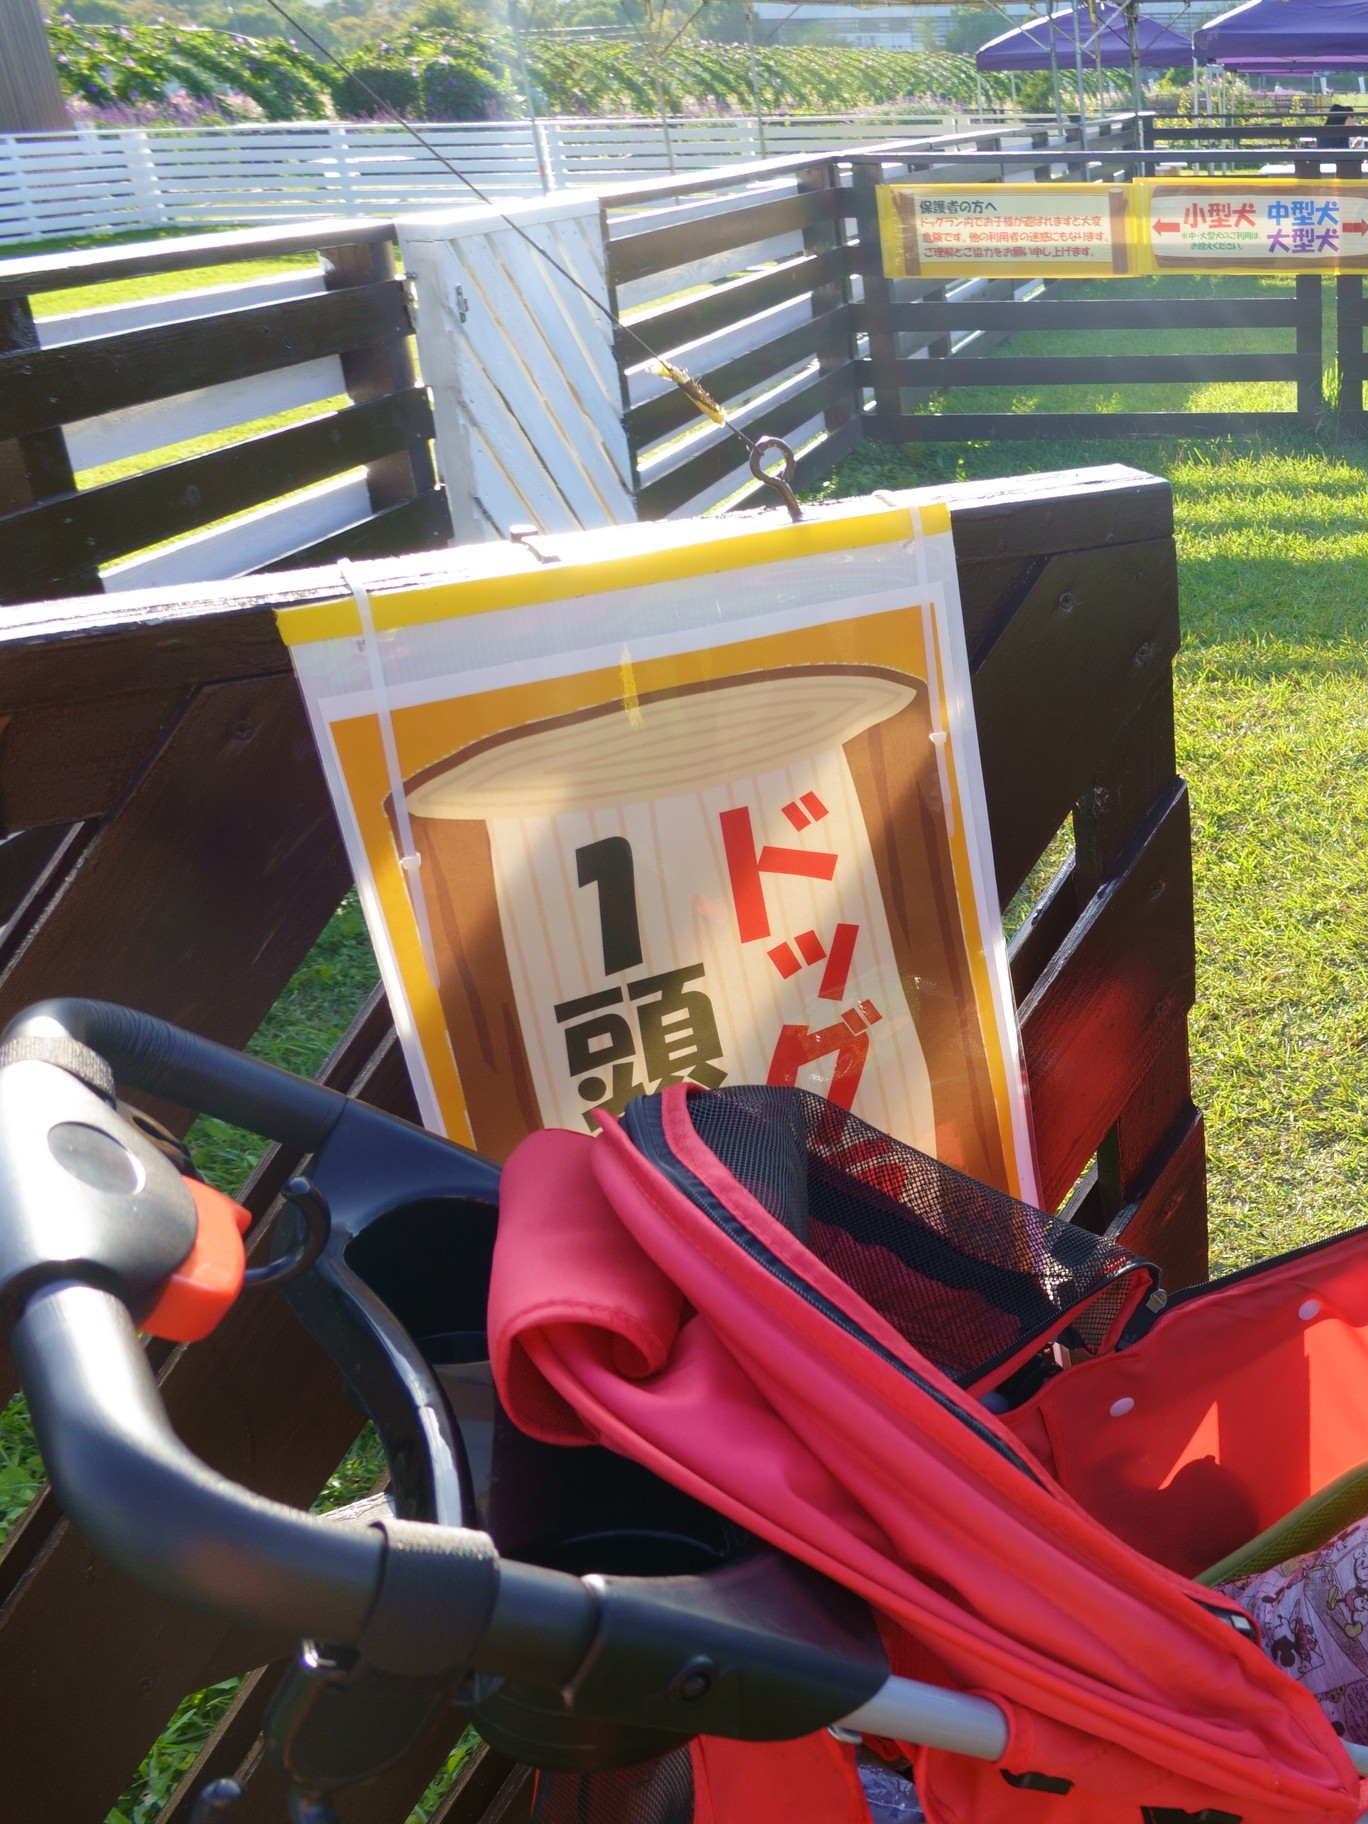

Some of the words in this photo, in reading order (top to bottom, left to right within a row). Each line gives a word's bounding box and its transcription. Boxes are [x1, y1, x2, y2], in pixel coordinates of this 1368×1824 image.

[919, 200, 997, 214] 保護者の方へ
[1183, 202, 1257, 229] 小型犬
[1267, 200, 1339, 226] 中型犬
[1266, 228, 1340, 254] 大型犬
